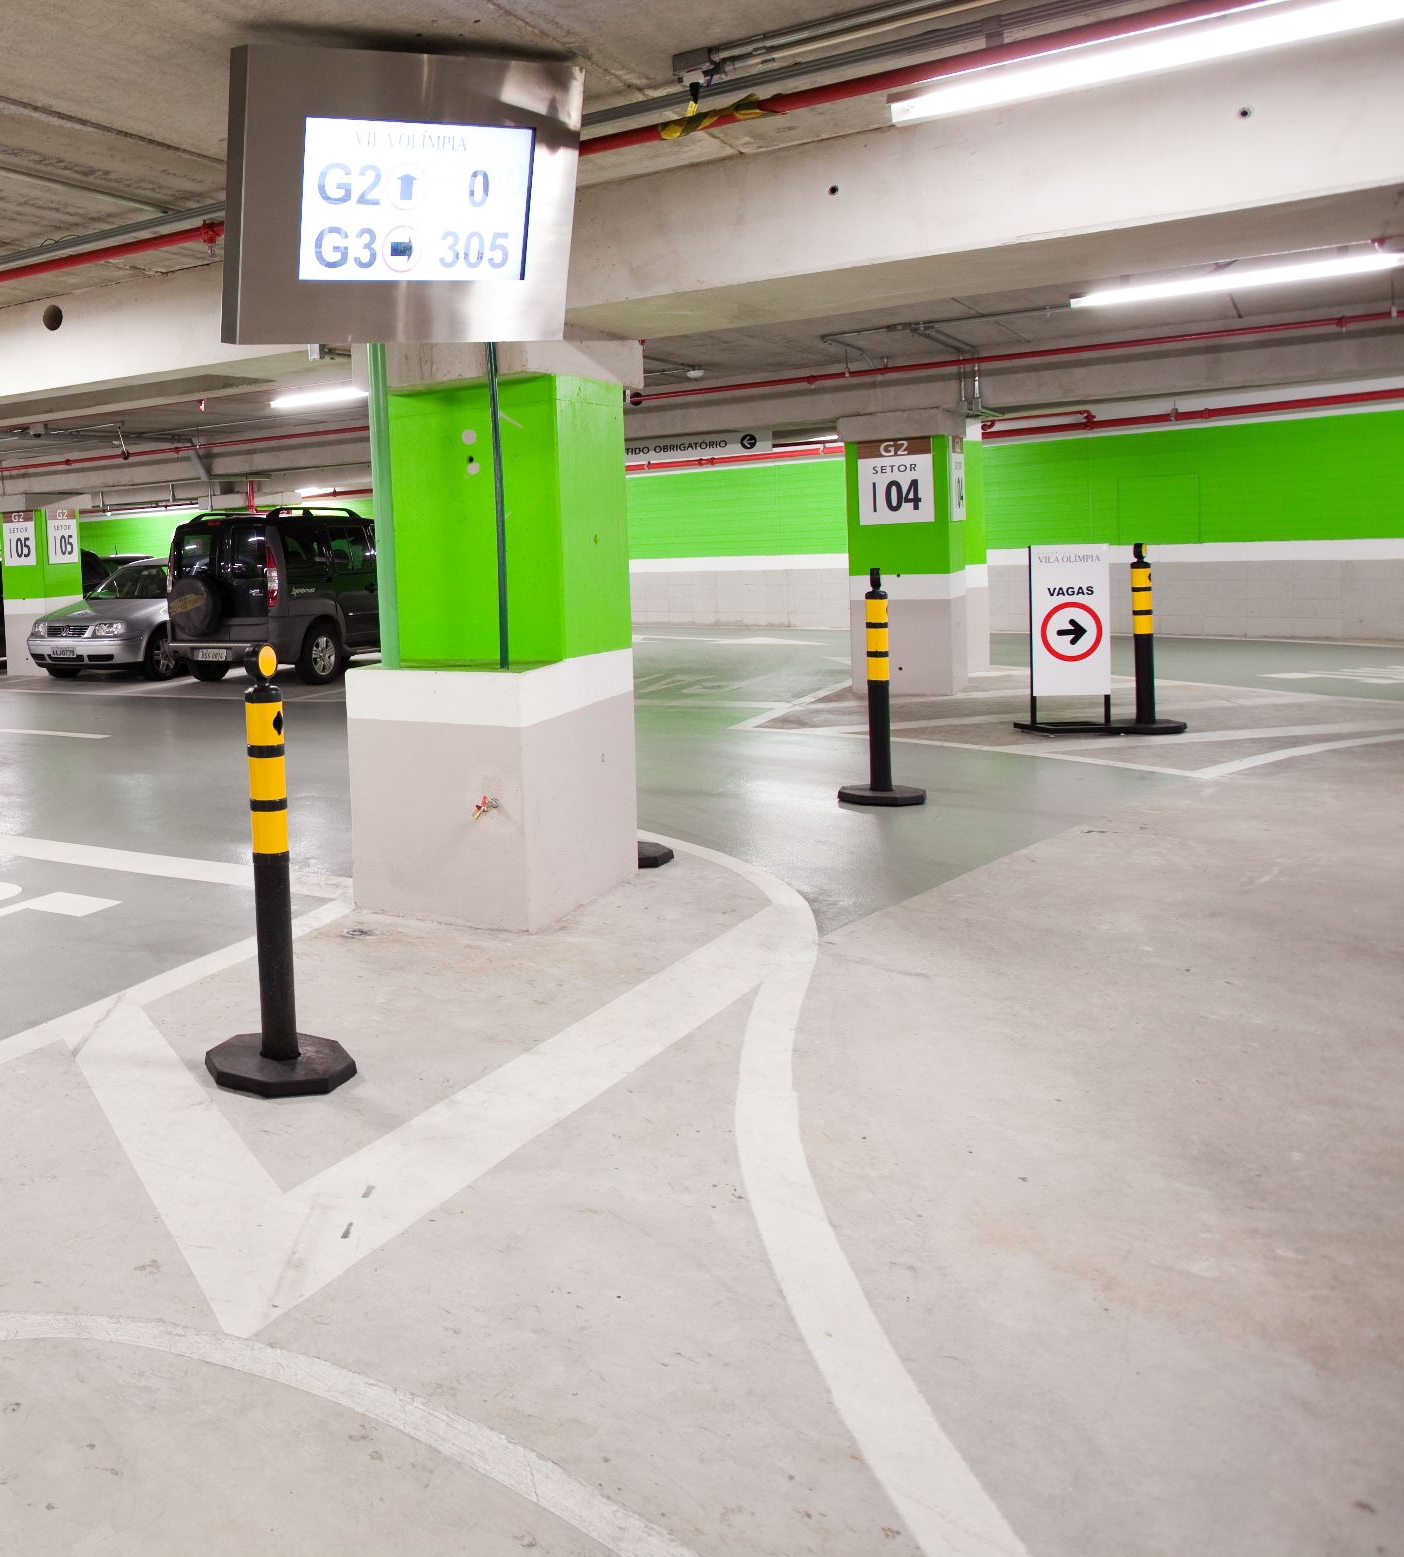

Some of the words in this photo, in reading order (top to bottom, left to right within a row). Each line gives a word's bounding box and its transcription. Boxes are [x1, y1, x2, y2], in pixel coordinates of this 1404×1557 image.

[355, 131, 393, 147] VILA
[399, 129, 466, 151] OLÍMPIA
[318, 162, 381, 205] G2
[469, 170, 489, 207] 0
[315, 226, 377, 268] G3
[439, 231, 509, 268] 305
[654, 439, 727, 453] OBRIGATÓRIO
[880, 441, 908, 456] G2
[873, 463, 917, 474] SETOR
[12, 513, 24, 521] G2
[57, 510, 67, 519] G2
[1047, 586, 1094, 596] VAGAS
